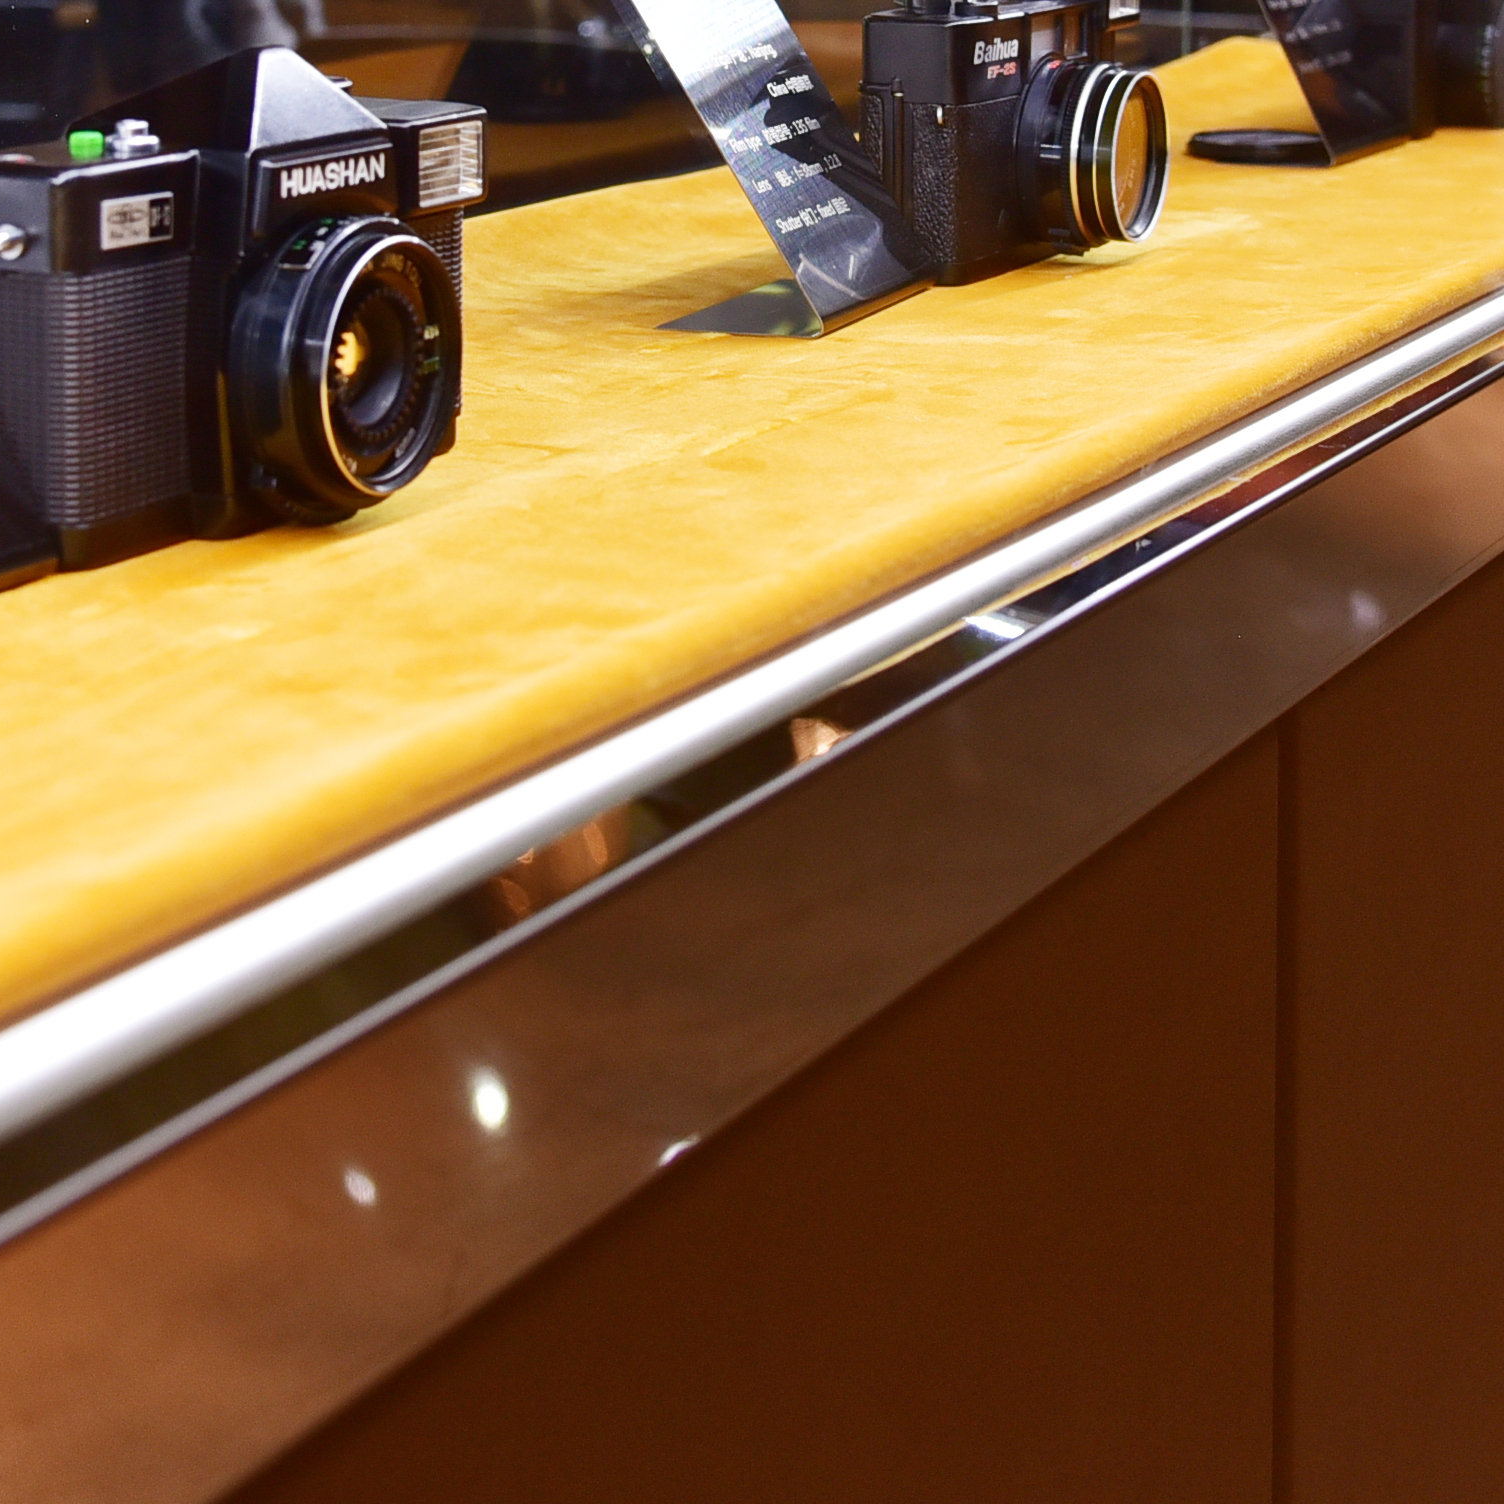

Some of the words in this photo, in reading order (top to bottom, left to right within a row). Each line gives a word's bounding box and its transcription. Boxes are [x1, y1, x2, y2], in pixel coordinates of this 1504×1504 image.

[973, 37, 1019, 65] Baihua
[280, 152, 386, 199] HUASHAN
[752, 179, 772, 193] Lens
